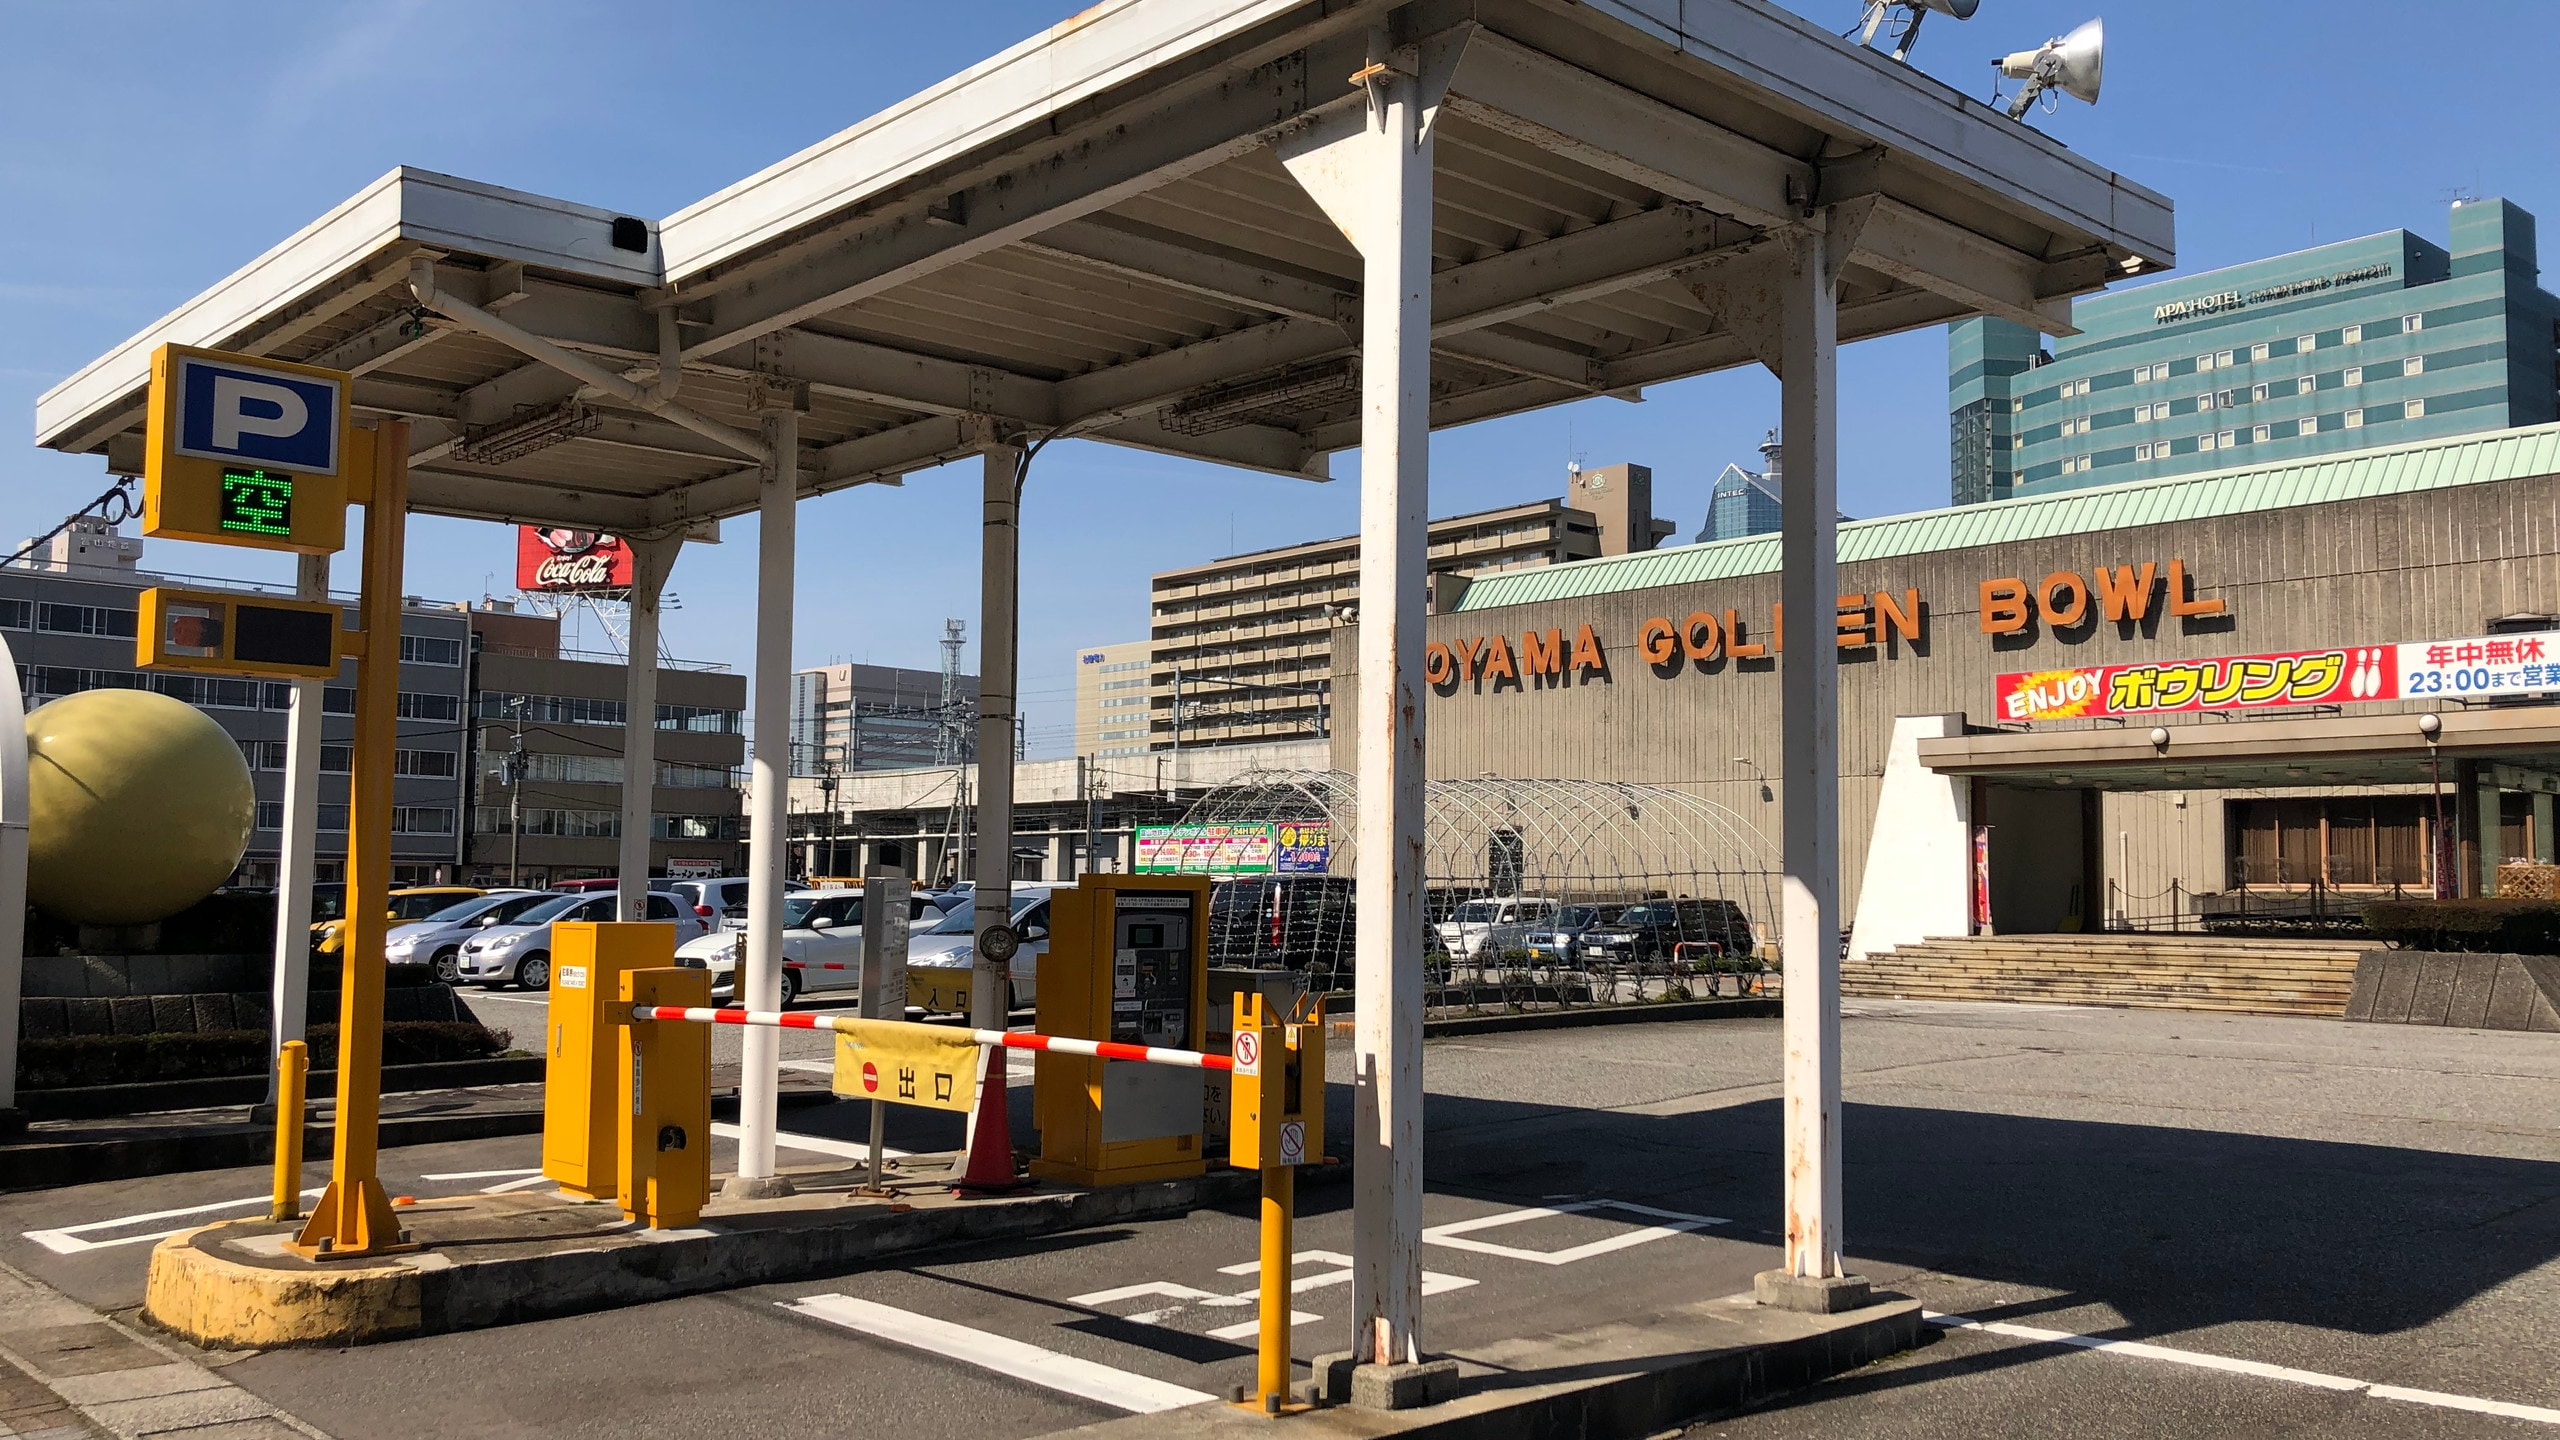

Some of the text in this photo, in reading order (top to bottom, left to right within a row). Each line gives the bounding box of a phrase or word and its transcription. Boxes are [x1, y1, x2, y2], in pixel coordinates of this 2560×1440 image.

[2154, 301, 2187, 319] APA
[2187, 290, 2243, 312] HOTEL
[212, 375, 308, 450] P
[221, 469, 292, 535] 空
[1717, 488, 1746, 499] INTEC
[535, 553, 613, 585] Coca-Cola
[1425, 558, 2226, 684] OYAMA GOLEN BOWL
[2426, 638, 2545, 668] 年中無休
[2004, 668, 2105, 718] ENJOY
[2109, 651, 2346, 711] ボウリング
[928, 988, 967, 1008] 入口
[898, 1066, 953, 1102] 出口
